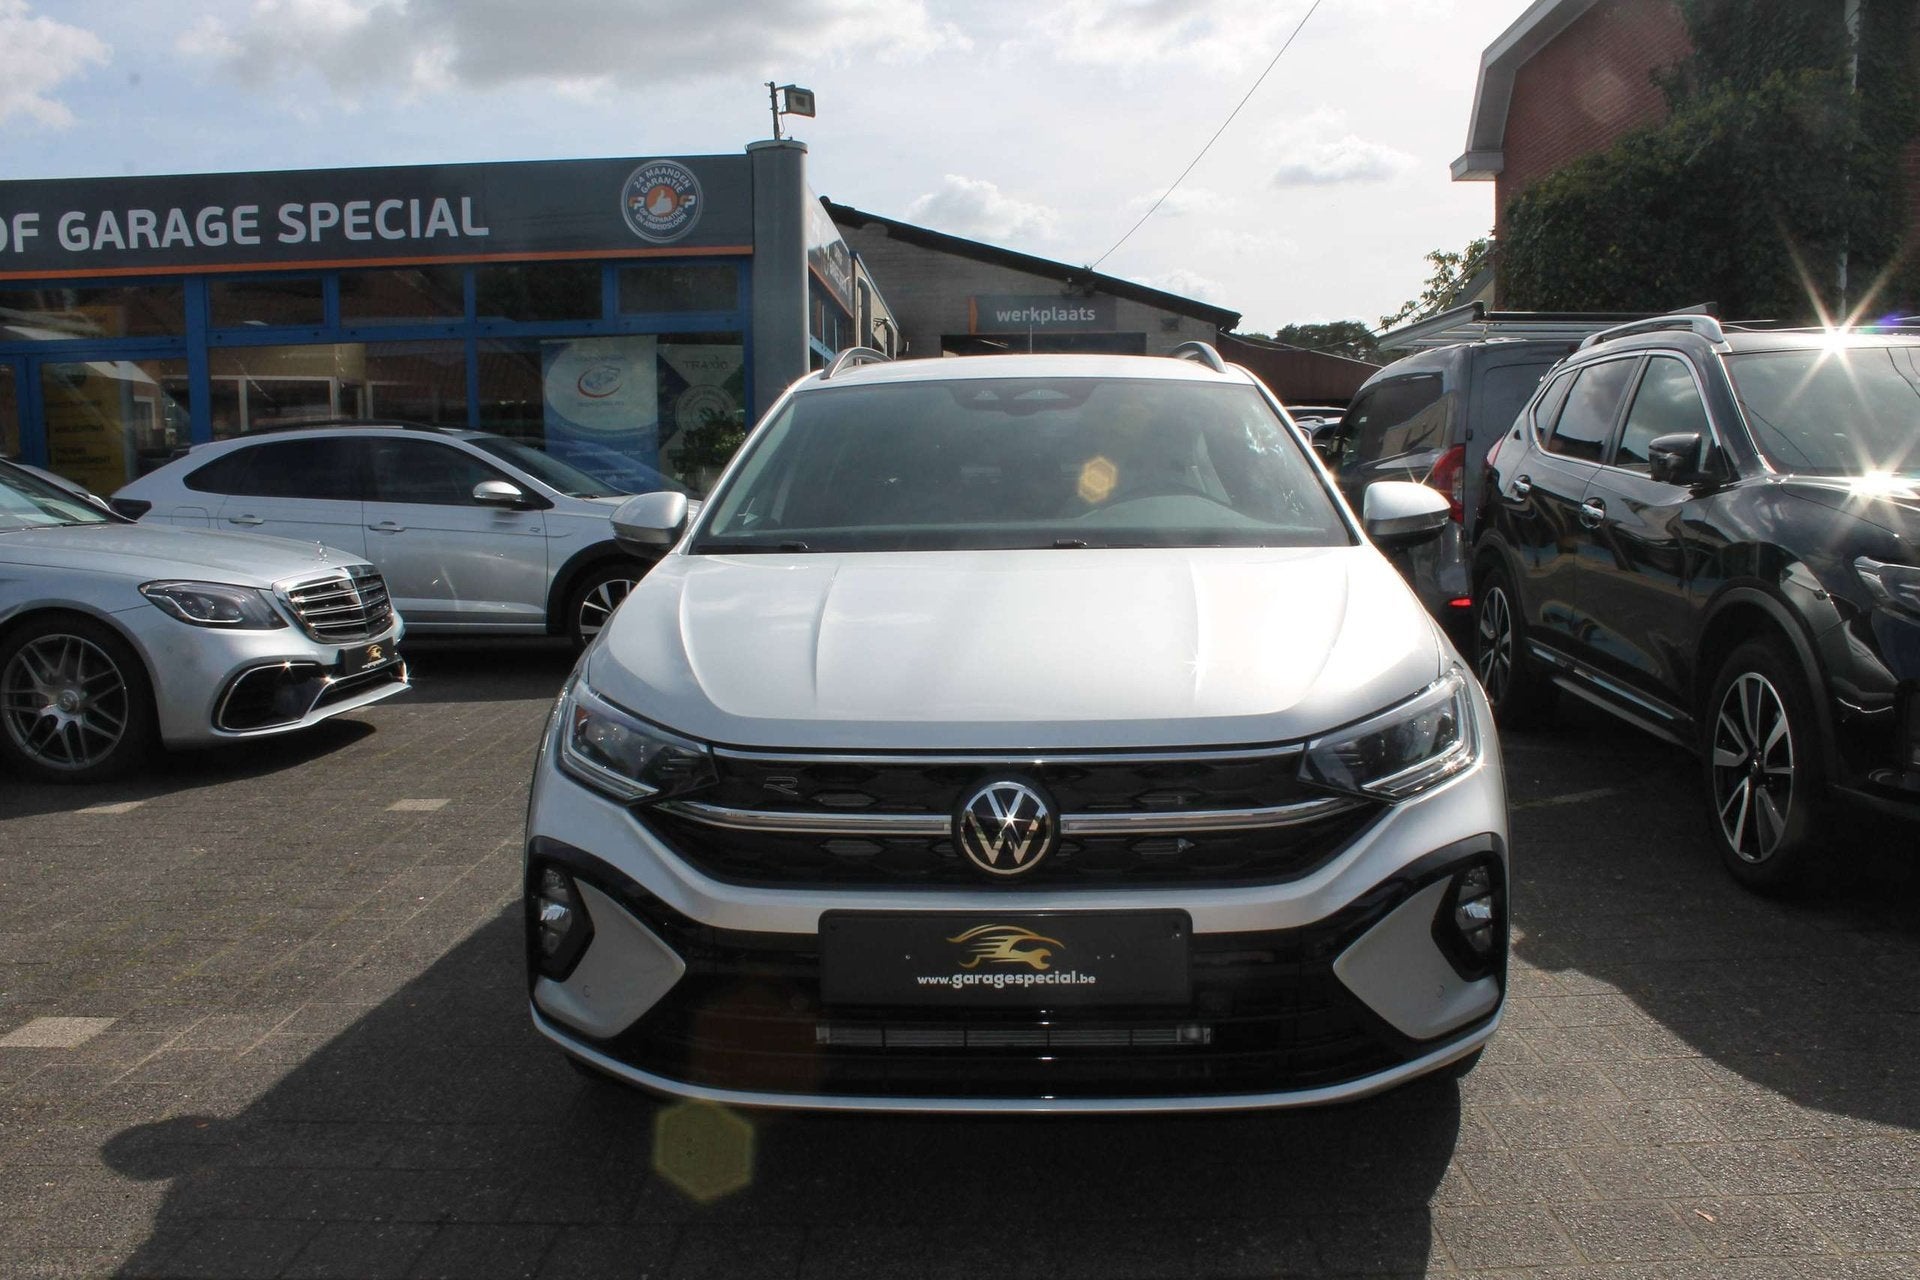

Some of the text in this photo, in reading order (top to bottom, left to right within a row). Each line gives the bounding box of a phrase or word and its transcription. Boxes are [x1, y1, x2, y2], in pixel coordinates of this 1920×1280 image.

[634, 167, 691, 189] 24 MAANDEN
[640, 176, 685, 194] GARANTIE
[0, 196, 489, 252] F GARAGE SPECIAL
[996, 306, 1096, 325] werkplaats
[917, 970, 1096, 989] www.garagespecial.be
